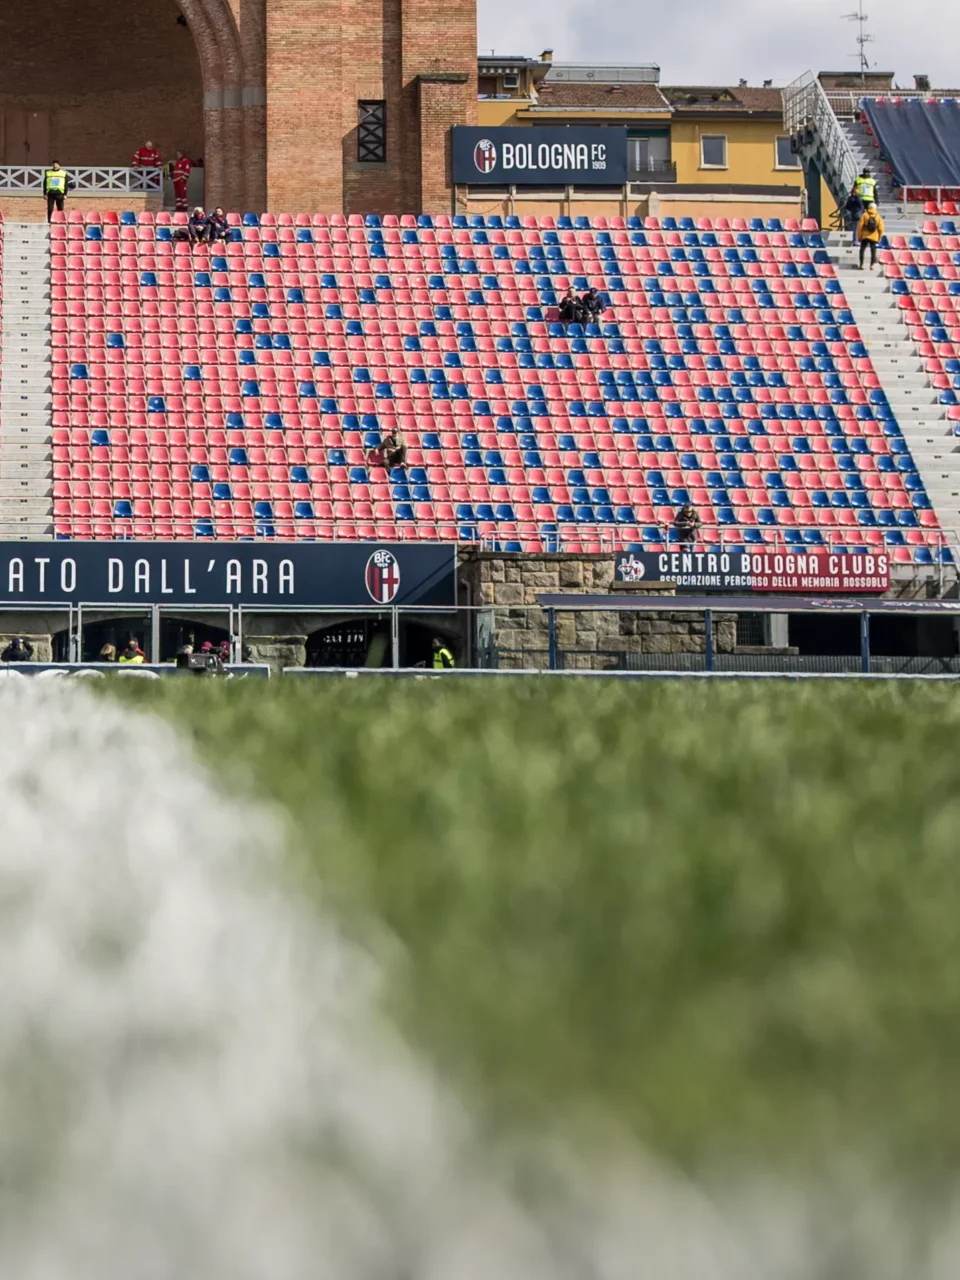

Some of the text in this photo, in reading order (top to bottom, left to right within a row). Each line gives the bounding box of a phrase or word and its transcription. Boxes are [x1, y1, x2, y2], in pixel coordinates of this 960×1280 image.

[502, 143, 606, 169] BOLOGNA FC
[592, 161, 606, 170] 1909
[374, 551, 390, 563] BFC
[658, 553, 888, 575] CENTRO BOLOGNA CLUBS
[108, 558, 295, 594] DALL'ARA
[724, 575, 768, 586] PERCORSO
[772, 576, 798, 587] DELLA
[801, 576, 840, 587] MEMORIA
[843, 577, 888, 588] ROSSOBLU
